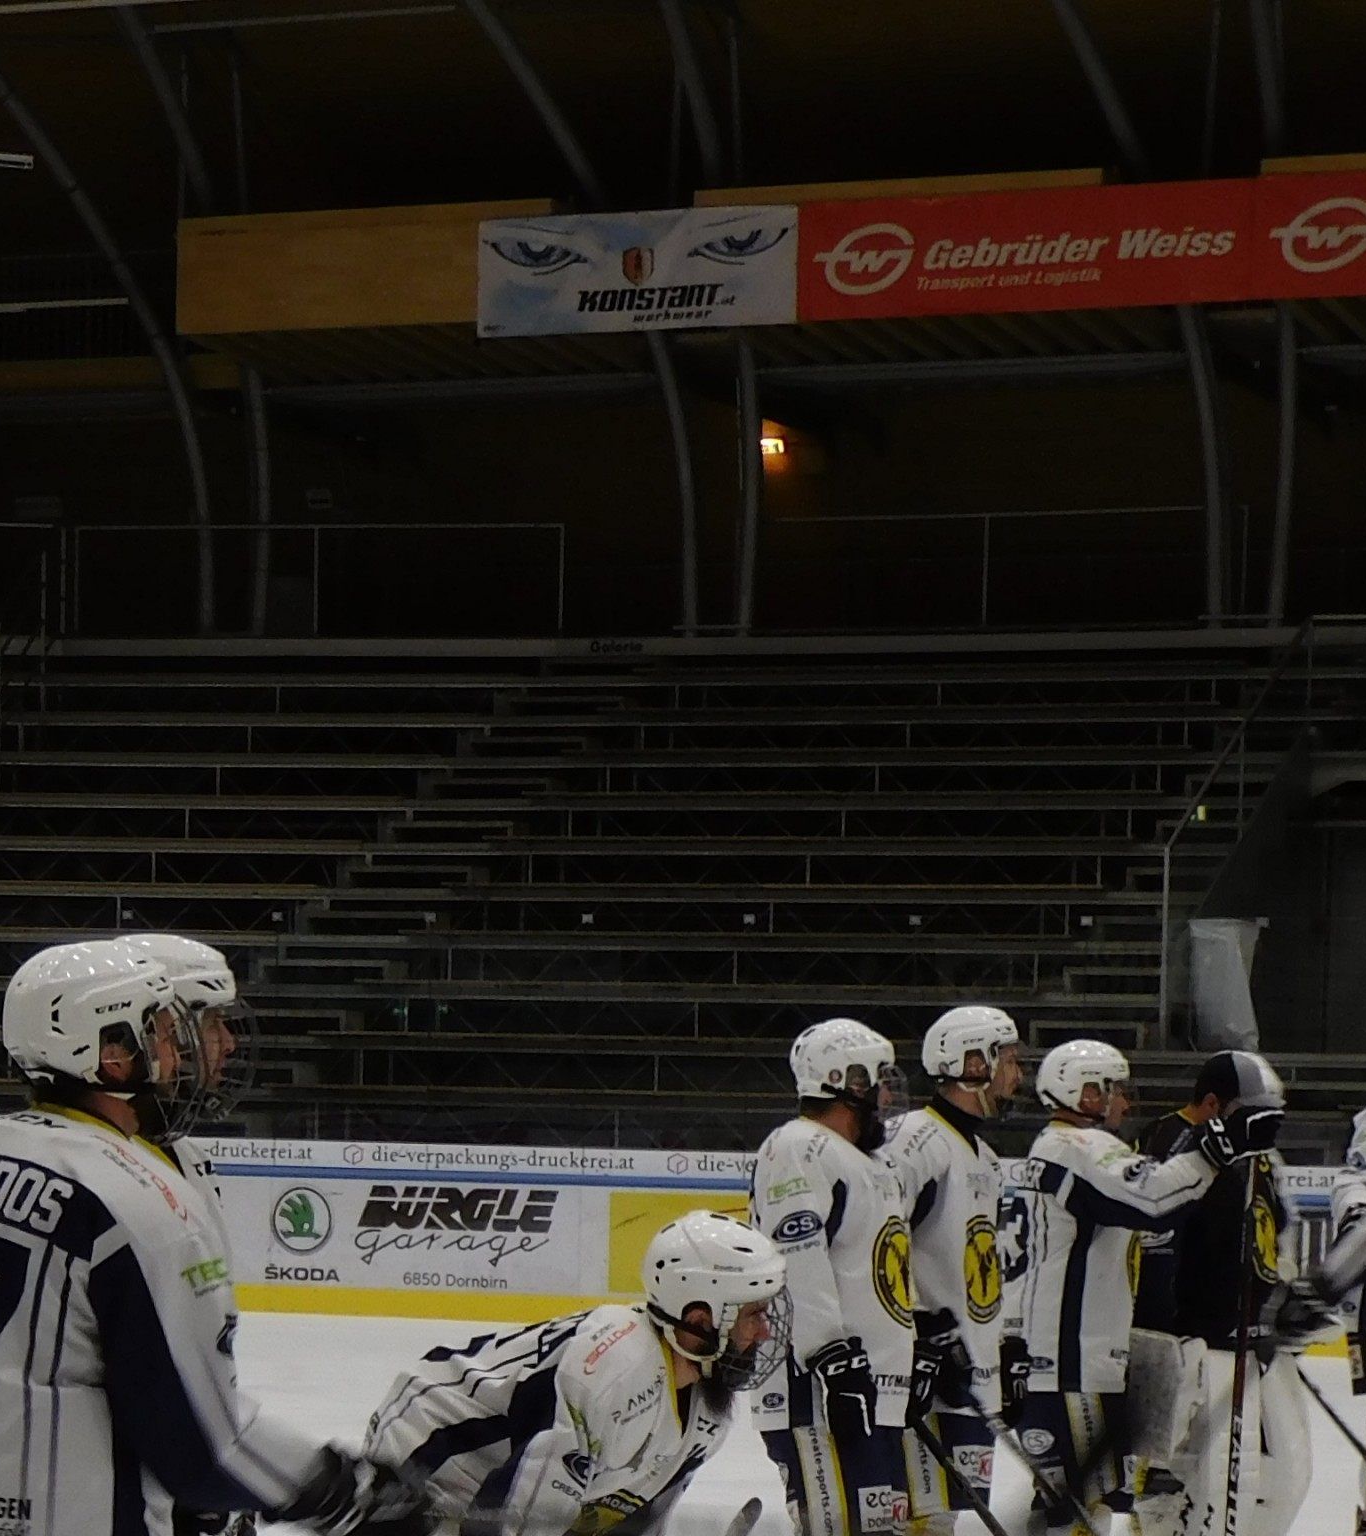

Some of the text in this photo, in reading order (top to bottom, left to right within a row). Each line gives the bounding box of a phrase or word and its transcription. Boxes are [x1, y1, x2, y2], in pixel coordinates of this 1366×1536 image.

[922, 224, 1235, 272] Gebrüder Weiss
[916, 273, 995, 293] Transport
[1034, 268, 1102, 288] Logistik
[371, 1143, 634, 1171] die-verpackungs-druckerei.at
[782, 1216, 816, 1235] CS
[354, 1228, 550, 1267] garage
[264, 1262, 341, 1283] ŠKODA
[402, 1271, 508, 1290] 6850 Dornbirn
